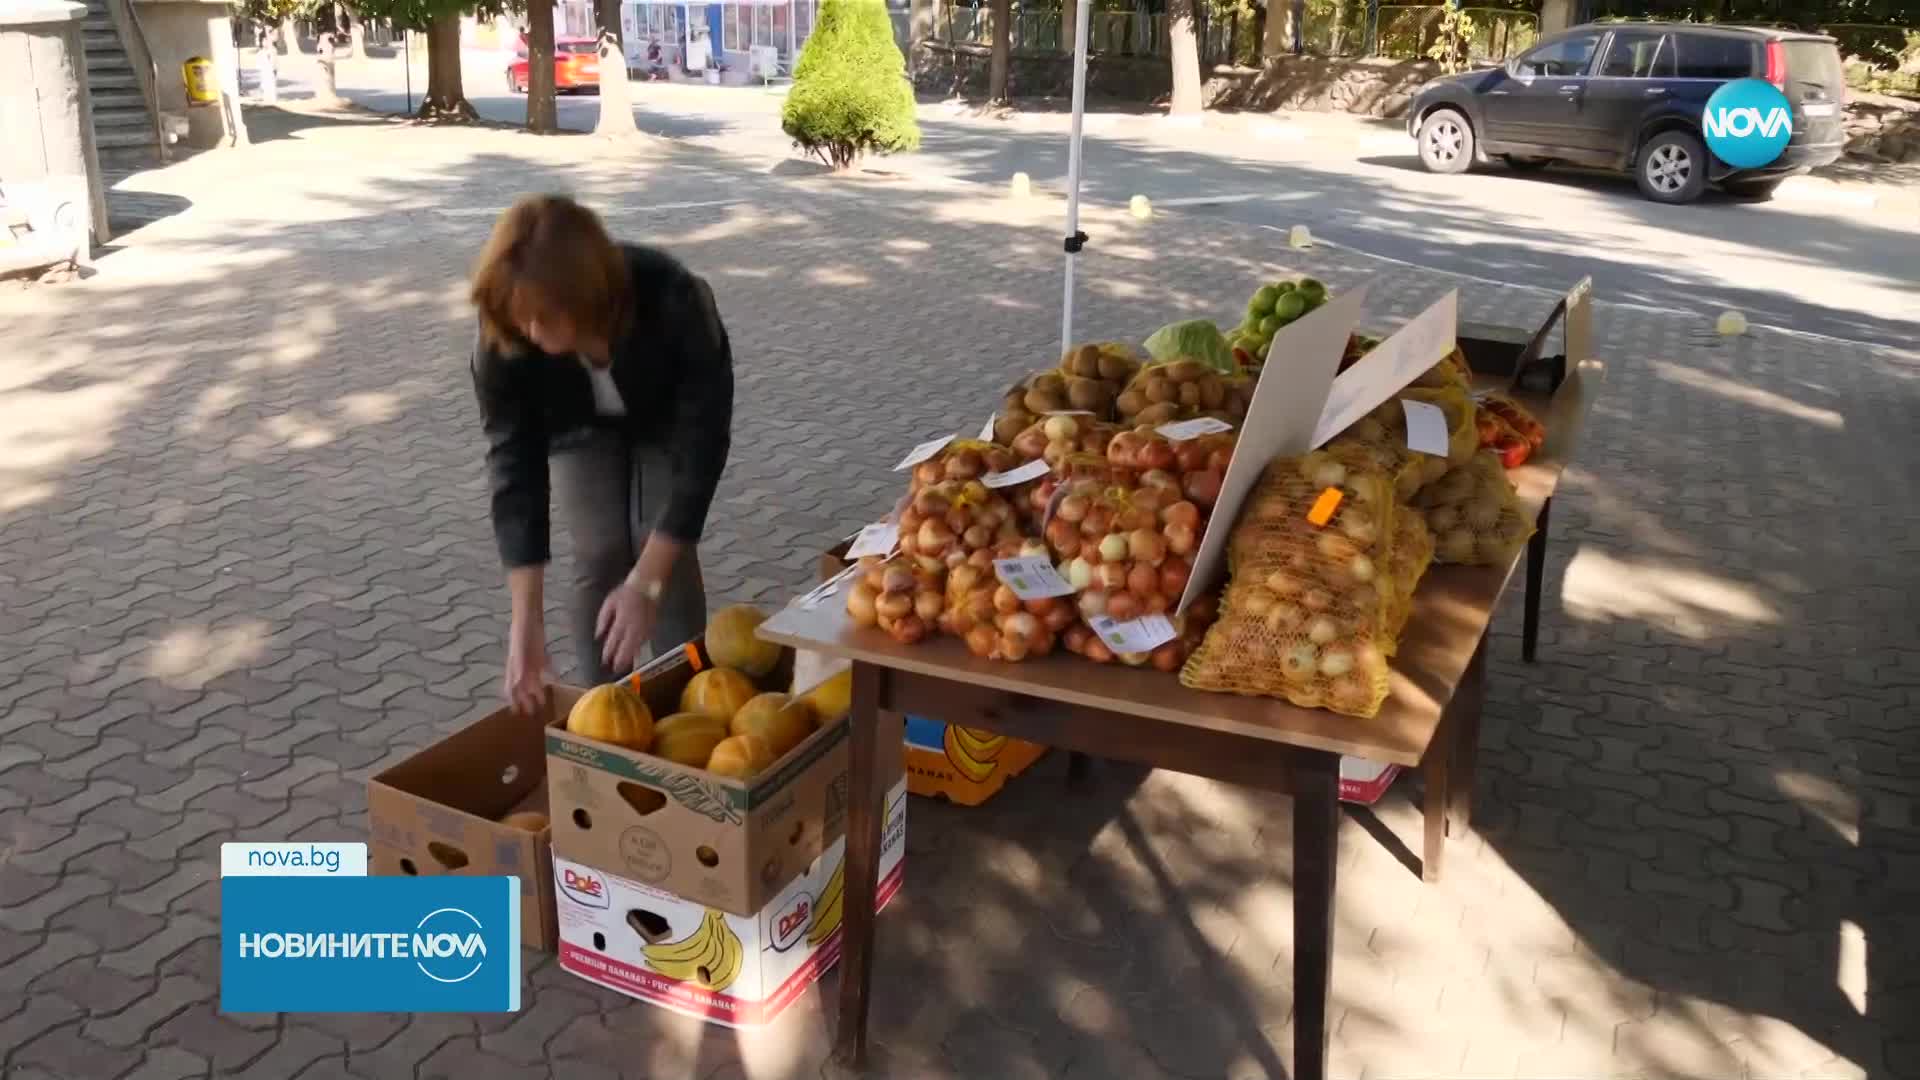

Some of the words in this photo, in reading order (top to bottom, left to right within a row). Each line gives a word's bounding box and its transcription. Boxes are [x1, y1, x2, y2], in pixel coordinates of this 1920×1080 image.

[564, 868, 602, 895] Dole
[779, 900, 809, 937] Dole
[608, 965, 647, 985] BANANAS
